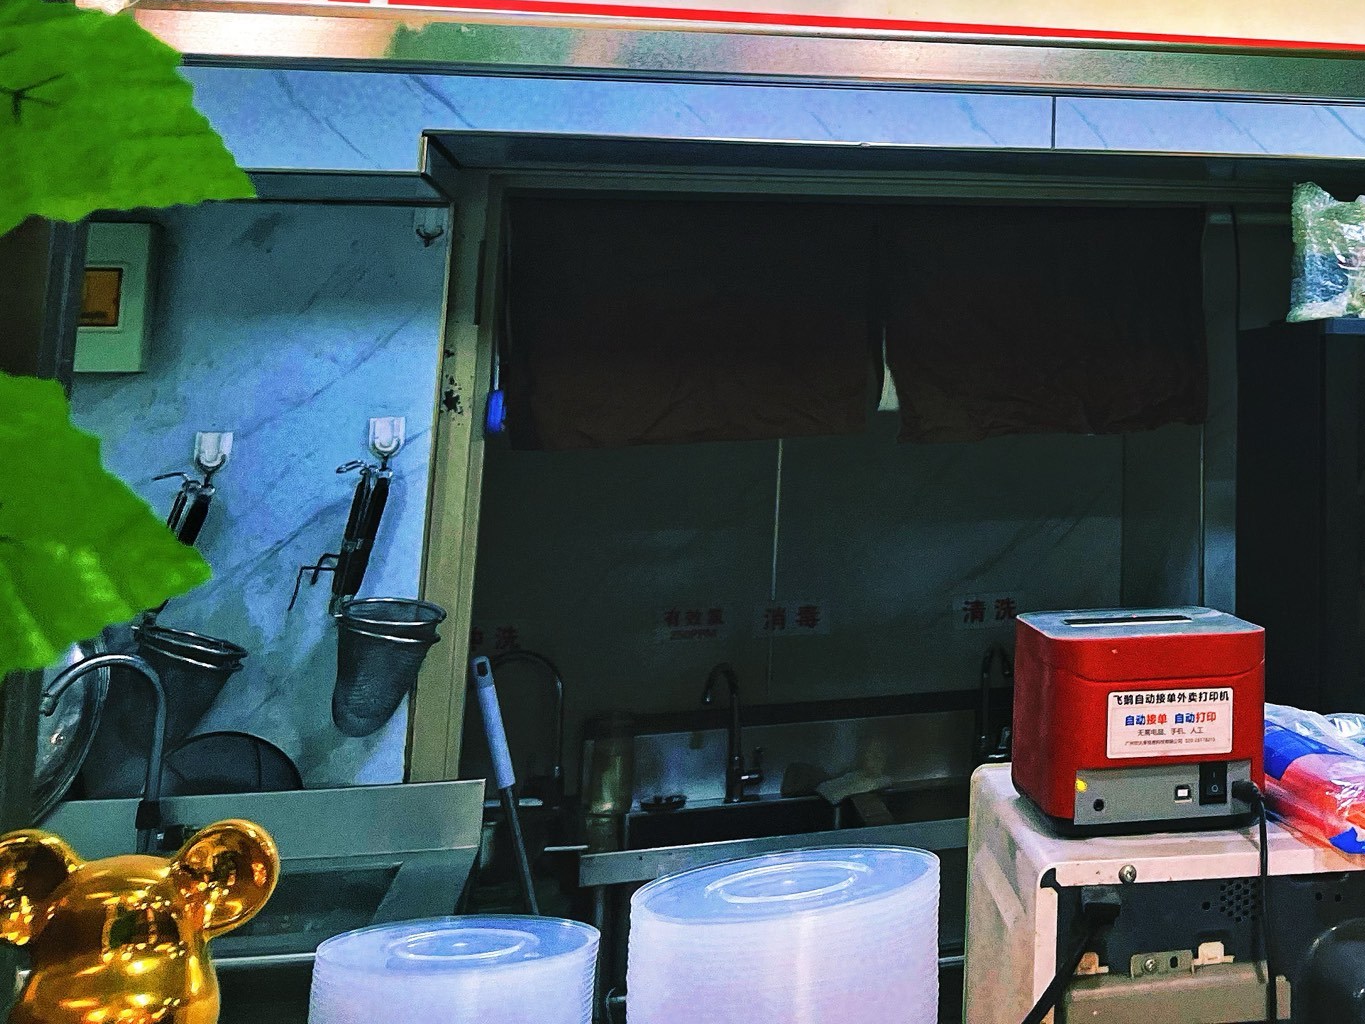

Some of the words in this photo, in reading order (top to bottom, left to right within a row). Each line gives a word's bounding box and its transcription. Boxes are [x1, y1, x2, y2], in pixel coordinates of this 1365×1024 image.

[1125, 713, 1168, 726] 自动接单
[1174, 711, 1217, 725] 自动打印
